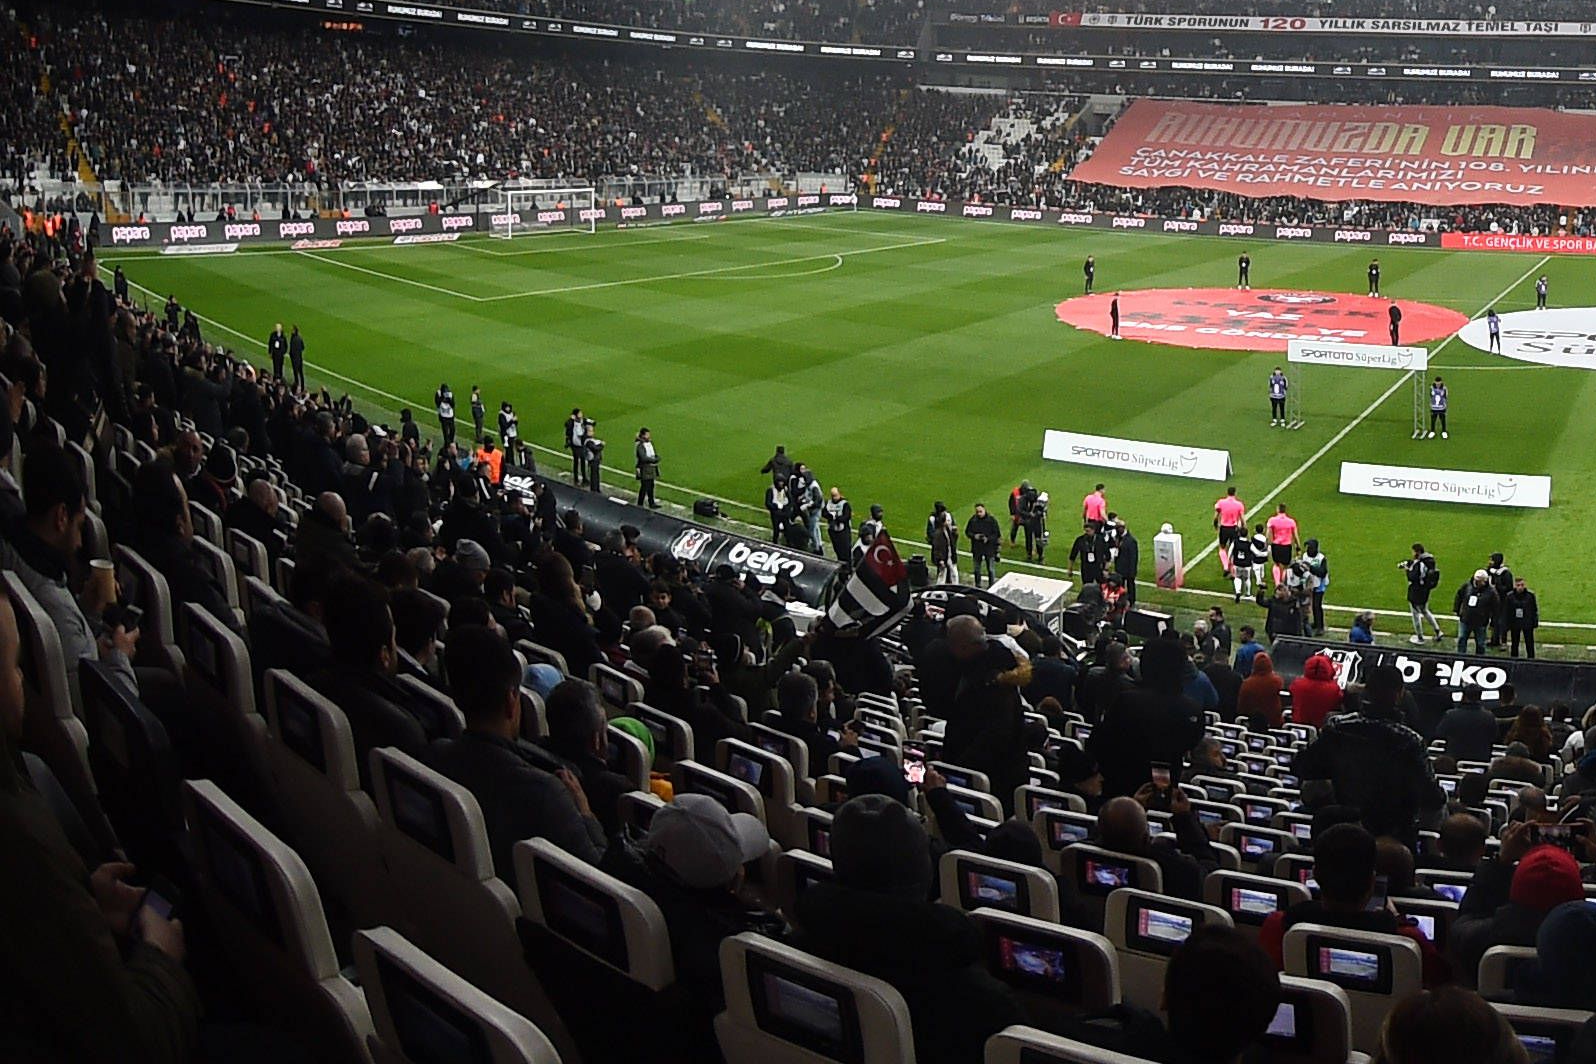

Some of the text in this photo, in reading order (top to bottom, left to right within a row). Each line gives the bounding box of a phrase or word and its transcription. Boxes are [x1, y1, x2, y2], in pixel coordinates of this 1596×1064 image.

[1126, 14, 1163, 26] TÜRK
[1167, 16, 1249, 28] SPORUNUN
[1259, 18, 1307, 30] 120
[1320, 20, 1365, 29] YILLIK
[1371, 20, 1461, 32] SARSILMAZ
[1467, 21, 1518, 32] TEMEL
[1144, 112, 1430, 155] RUHUMUZDA
[1130, 156, 1464, 180] TÜM KAHRAMANLARIMIZI
[1136, 147, 1288, 163] ÇANAKKALE
[1459, 161, 1510, 172] 108.
[1119, 166, 1544, 195] SAYGI VE RAHMETLE ANIYORUZ
[1463, 236, 1483, 246] T.C.
[1486, 236, 1533, 249] GENÇLİK
[1536, 238, 1549, 248] VE
[1550, 239, 1583, 249] SPOR
[1071, 445, 1129, 462] SPORTOTO
[1372, 477, 1440, 491] SPORTOTO
[728, 542, 804, 578] beko
